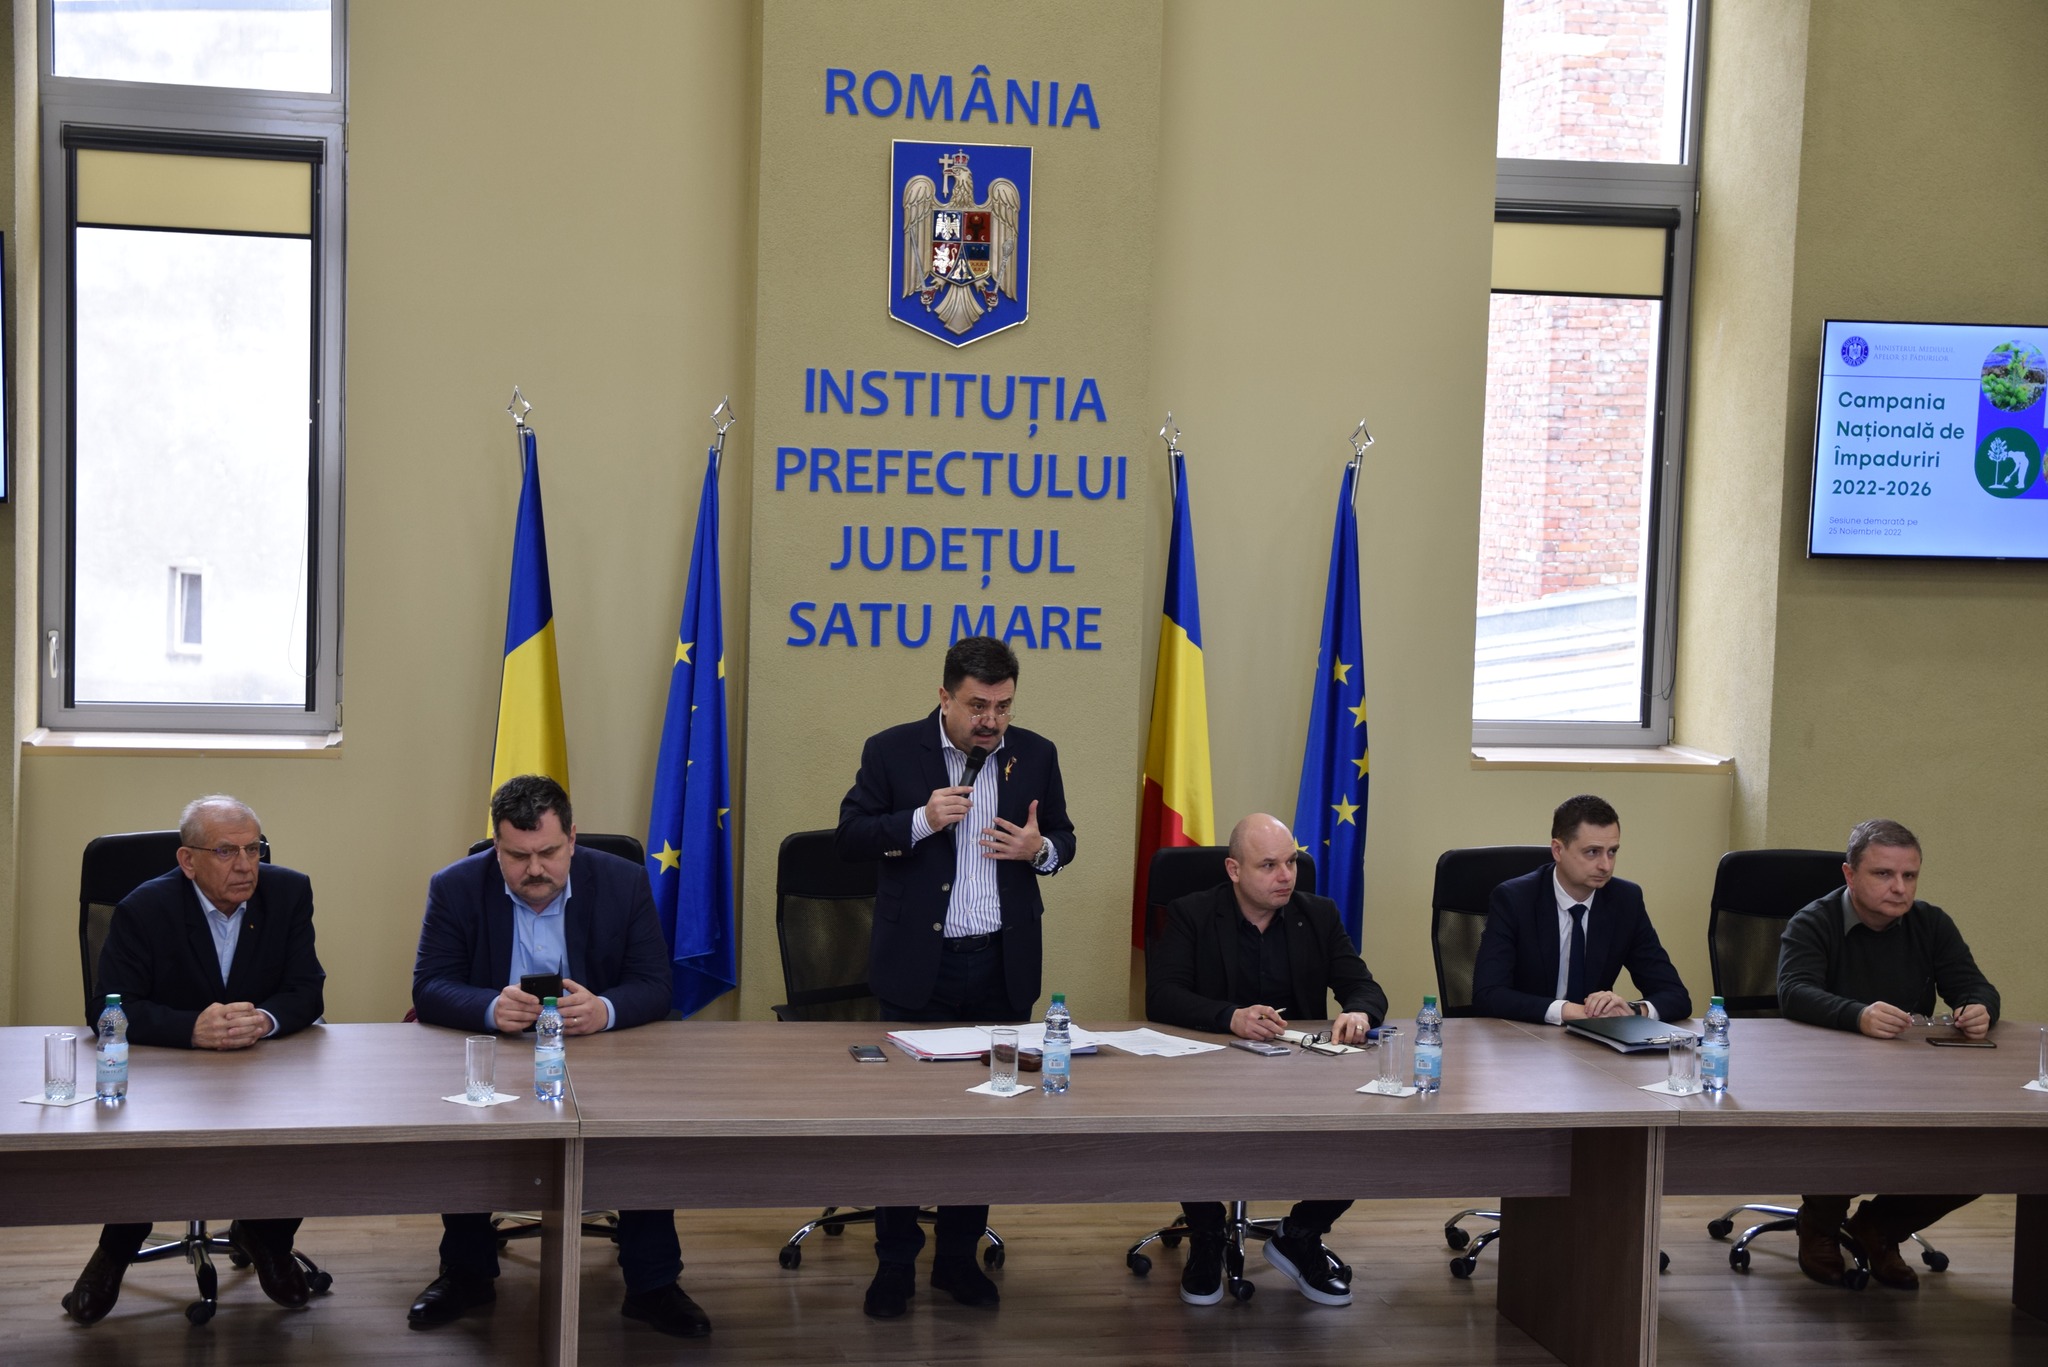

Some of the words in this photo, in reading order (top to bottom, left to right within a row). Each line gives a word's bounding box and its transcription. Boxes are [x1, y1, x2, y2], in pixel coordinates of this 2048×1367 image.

[825, 64, 1100, 129] ROMÂNIA
[1873, 353, 1900, 361] APELOR
[1874, 344, 1916, 352] MINISTERUL
[804, 368, 1108, 438] INSTITUȚIA
[1838, 391, 1946, 413] Campania
[1836, 420, 1935, 443] Națională
[1939, 422, 1965, 440] de
[1834, 445, 1940, 471] Împaduriri
[775, 447, 1127, 500] PREFECTULUI
[1832, 479, 1932, 497] 2022-2026
[1828, 527, 1838, 535] 25
[1839, 527, 1882, 536] Noiembrie
[1884, 528, 1902, 536] 2022
[1829, 516, 1862, 525] Sesiune
[1907, 519, 1918, 527] pe
[830, 525, 1075, 590] JUDEȚUL
[786, 601, 932, 648] SATU
[949, 604, 1102, 651] MARE
